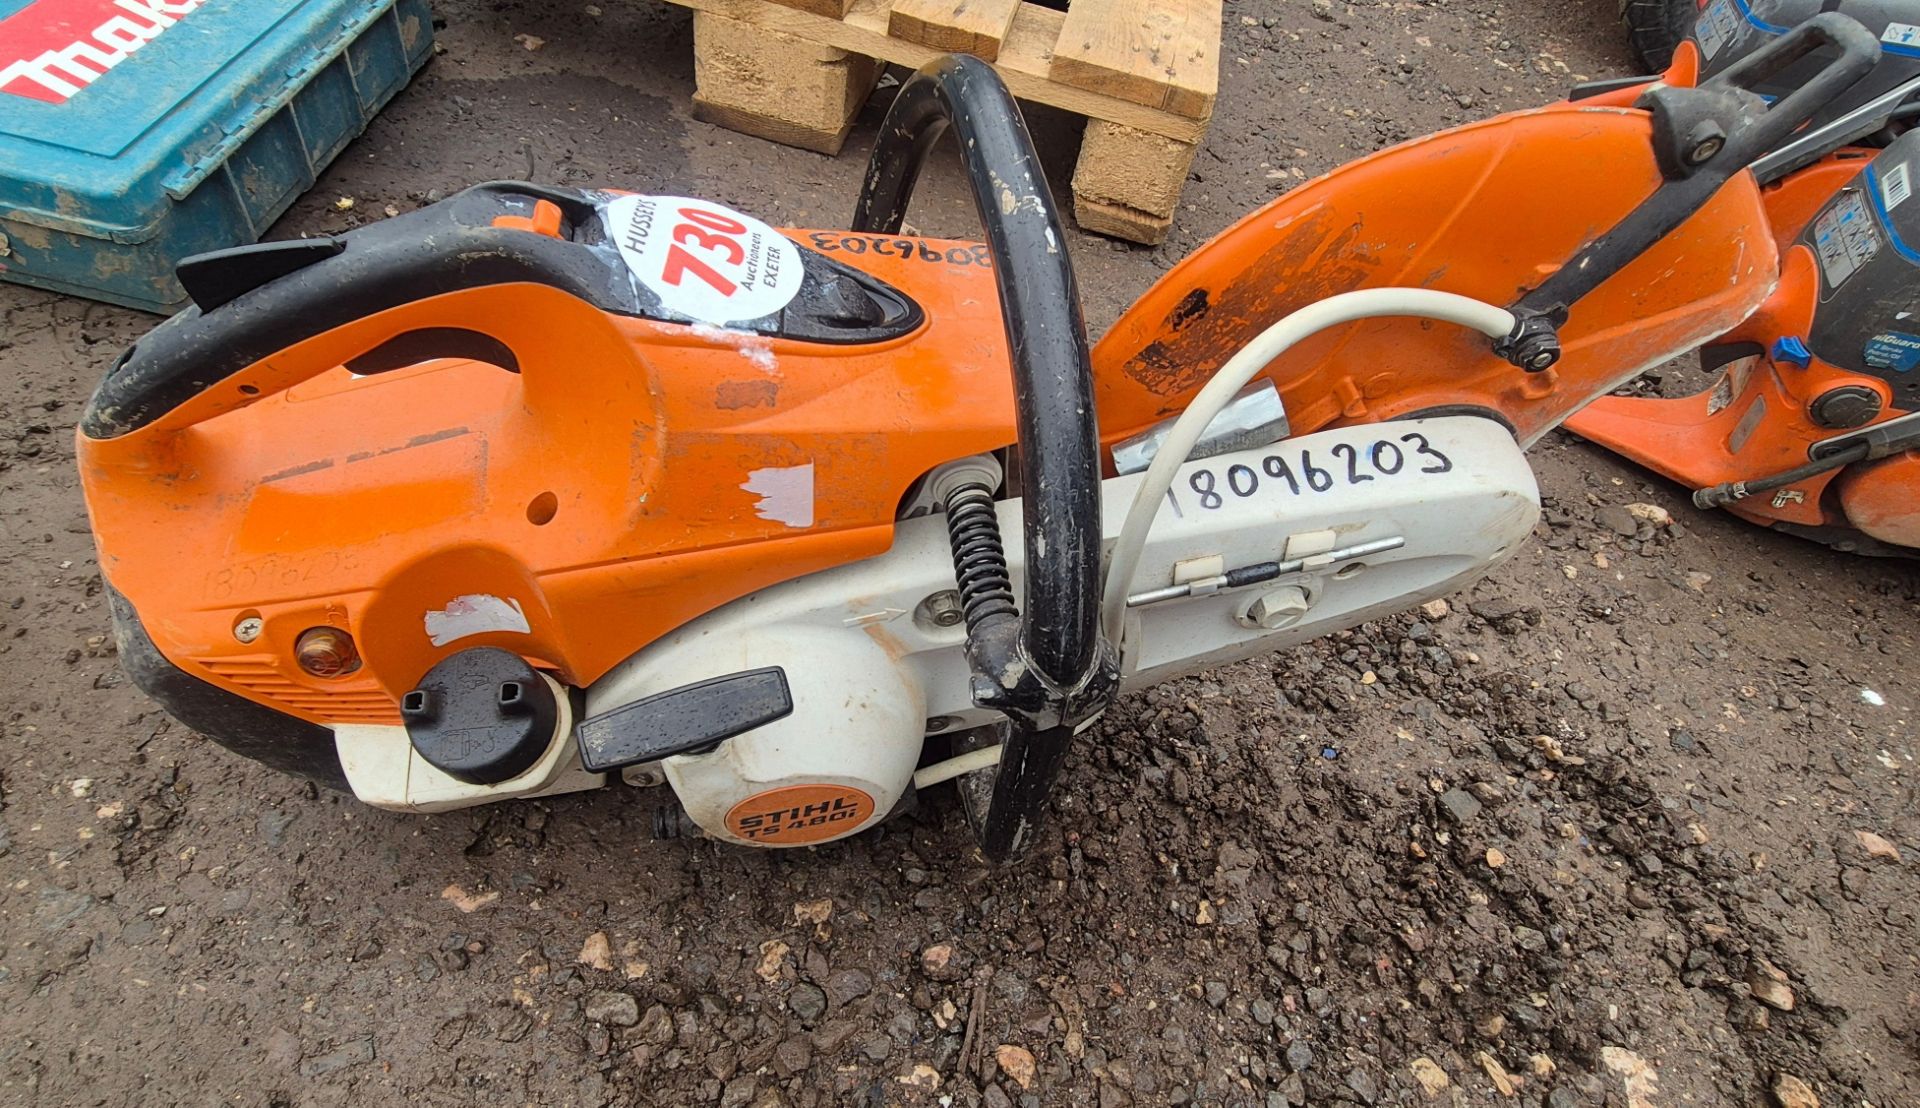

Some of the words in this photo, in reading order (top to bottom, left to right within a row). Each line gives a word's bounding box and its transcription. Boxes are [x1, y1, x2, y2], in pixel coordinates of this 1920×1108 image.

[0, 0, 206, 98] Mak
[624, 199, 657, 255] HUSSEYS
[661, 207, 747, 297] 730
[740, 232, 762, 292] Auctioneers
[763, 246, 781, 288] EXETER
[1166, 432, 1453, 518] 18096203
[739, 797, 858, 829] STIHL
[743, 825, 780, 838] TS
[787, 808, 857, 829] 480i
